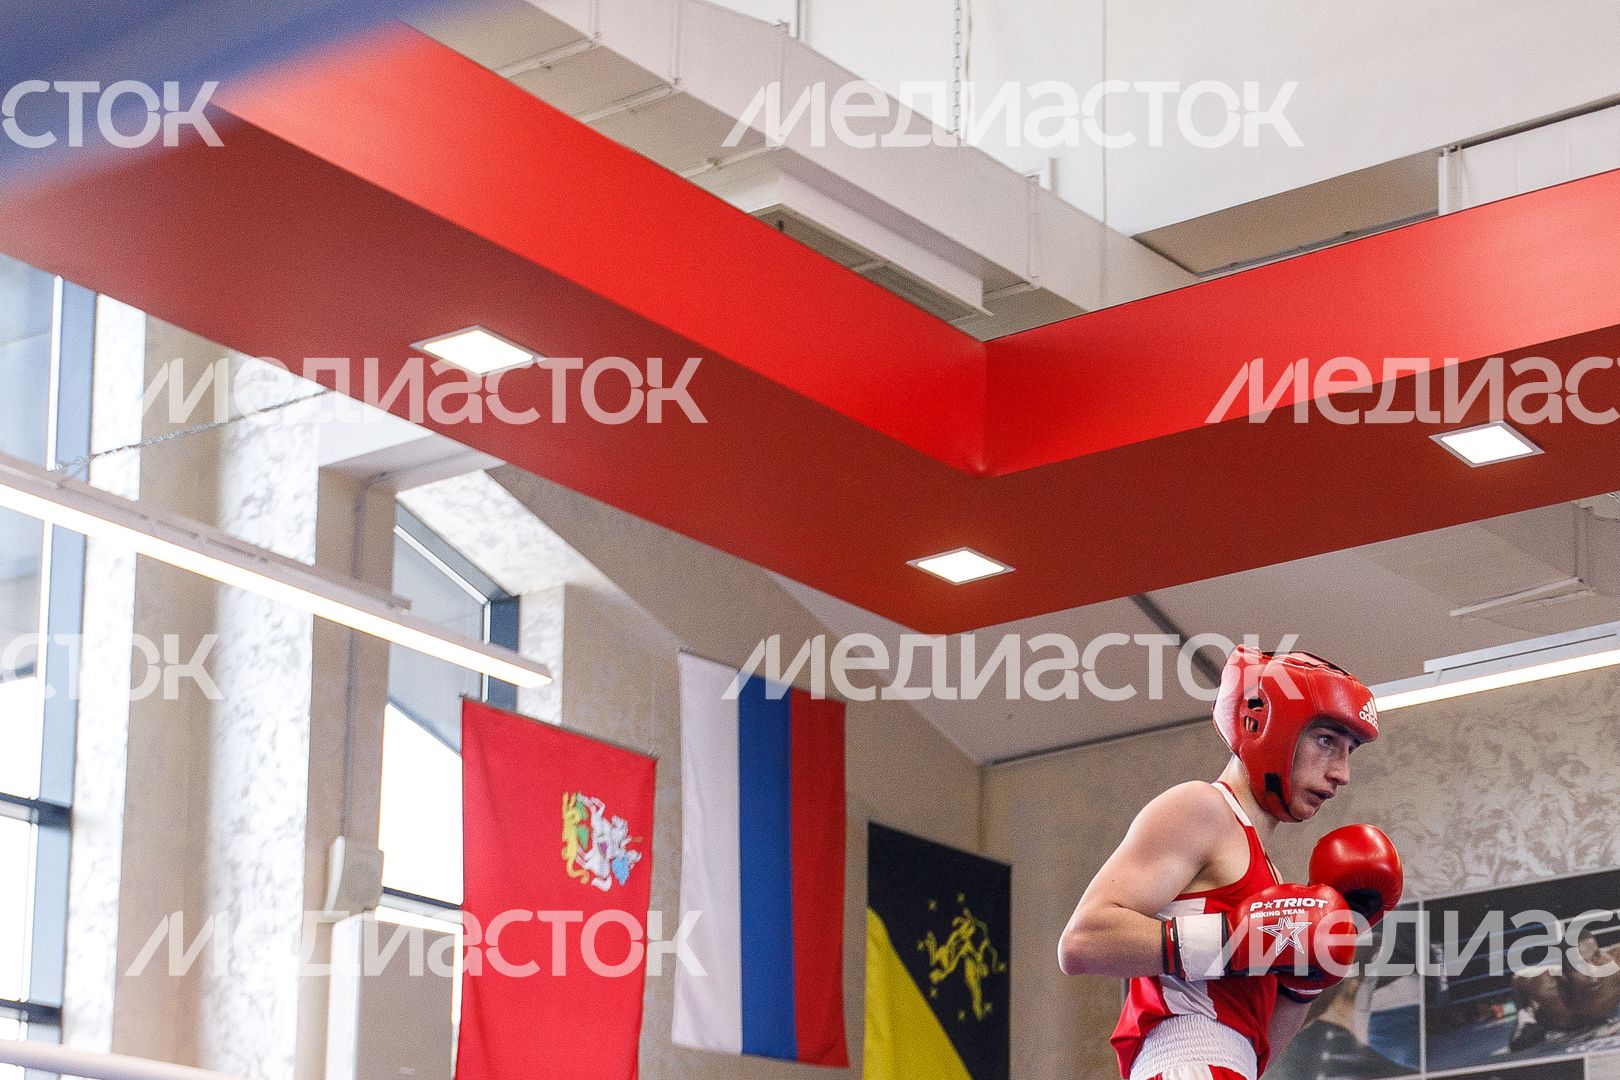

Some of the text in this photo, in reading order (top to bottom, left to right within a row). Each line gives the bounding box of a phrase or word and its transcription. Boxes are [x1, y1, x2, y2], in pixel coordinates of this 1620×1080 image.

[1249, 897, 1328, 912] PTRIOT
[1250, 908, 1306, 919] BOXING TEAM
